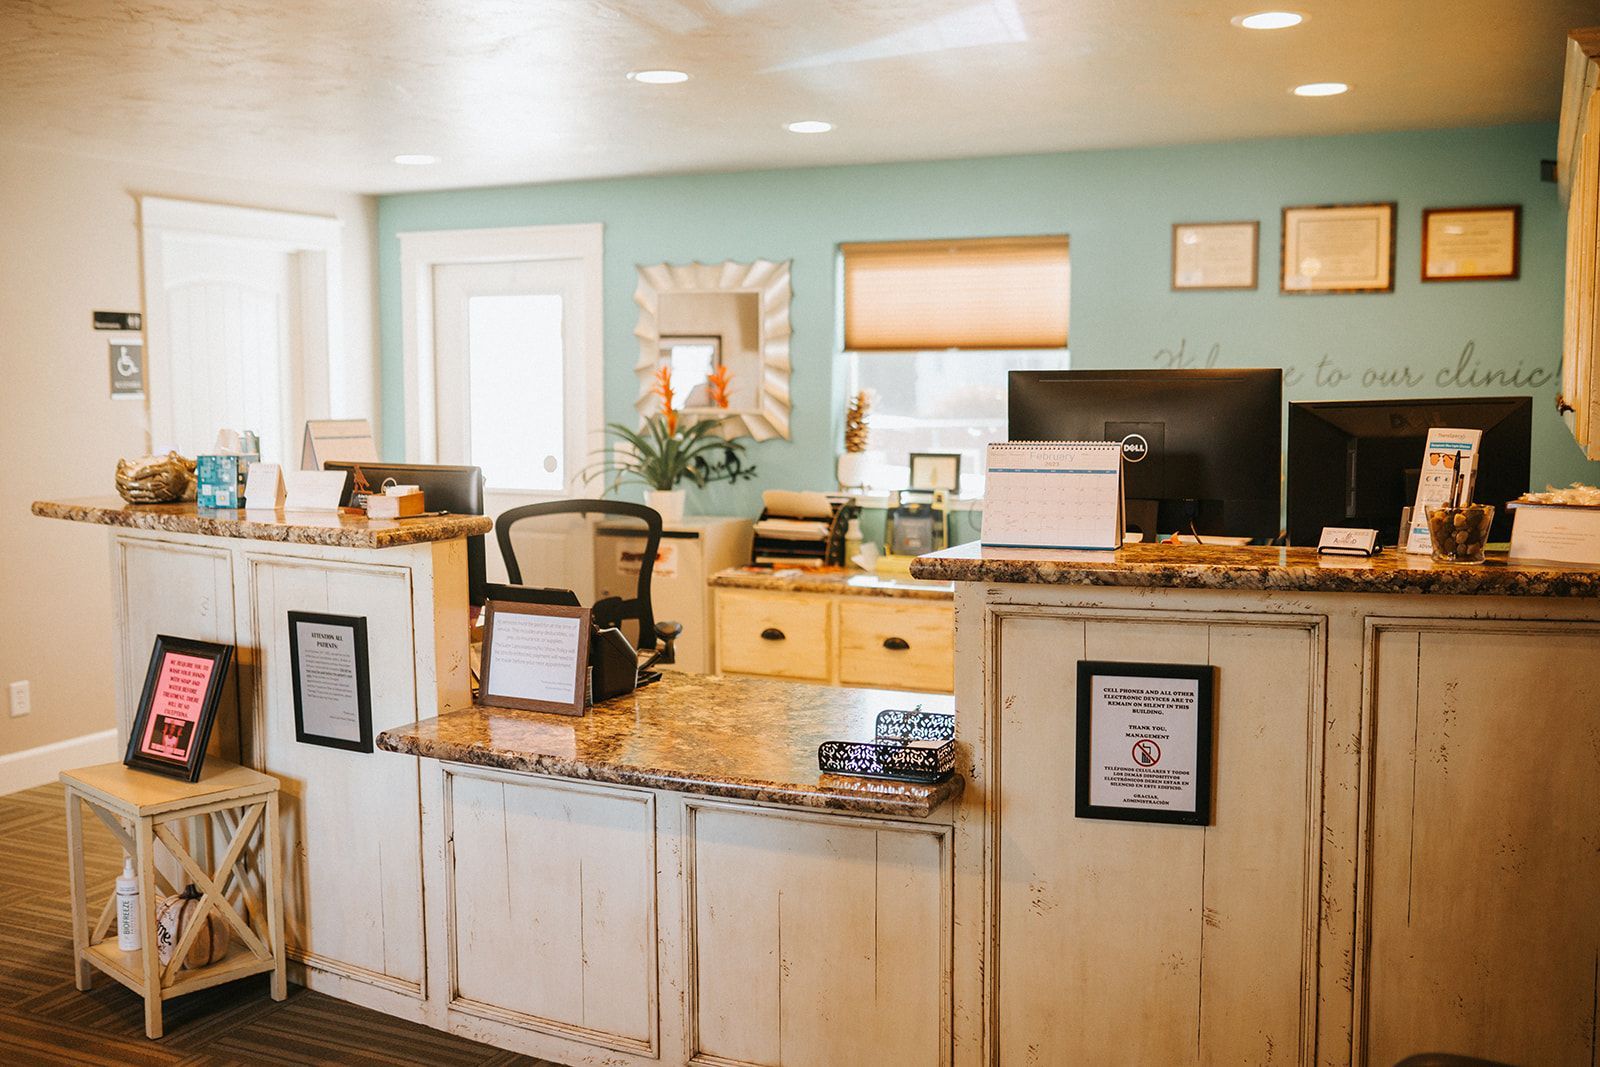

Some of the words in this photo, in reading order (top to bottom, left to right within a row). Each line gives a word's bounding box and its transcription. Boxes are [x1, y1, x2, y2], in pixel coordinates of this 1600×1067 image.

[1316, 353, 1349, 388] to
[1362, 366, 1423, 388] our
[1030, 452, 1076, 462] February
